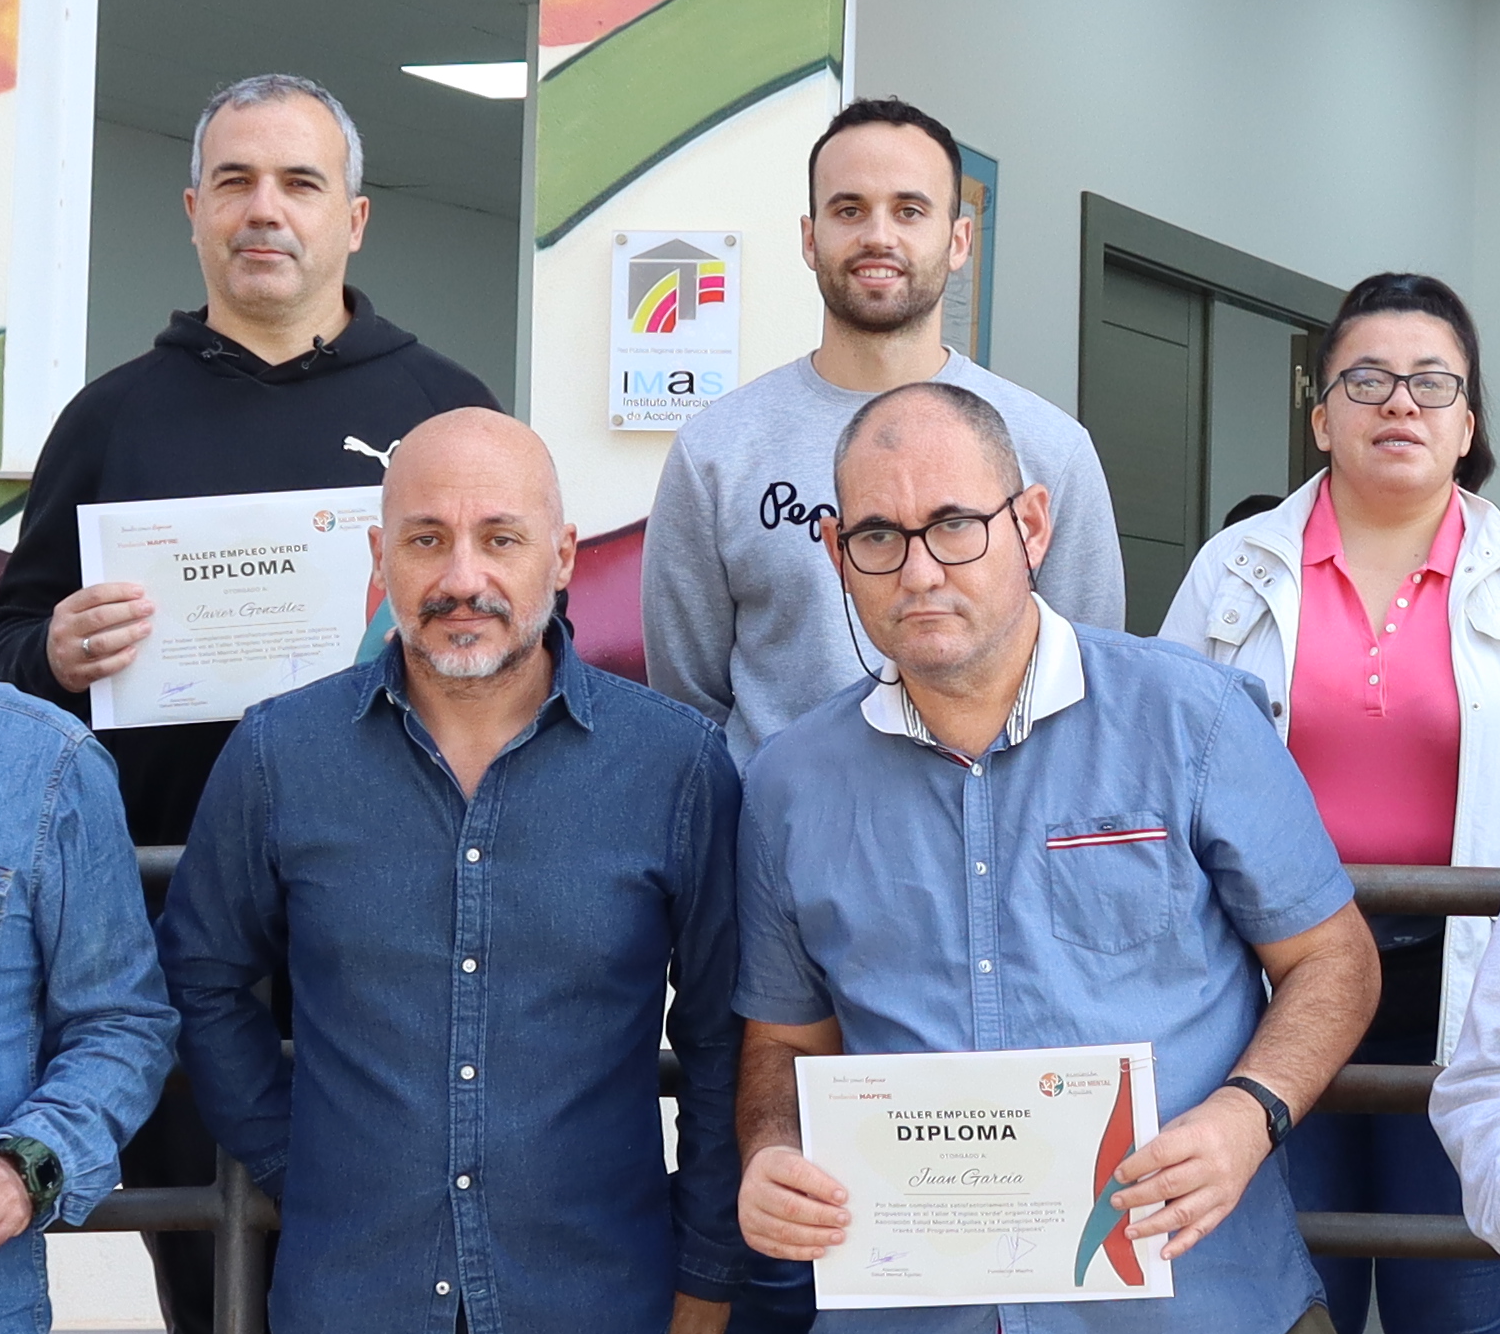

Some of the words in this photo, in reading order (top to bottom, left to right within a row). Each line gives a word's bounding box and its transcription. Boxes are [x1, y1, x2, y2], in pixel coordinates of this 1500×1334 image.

[623, 397, 667, 407] Instituto
[671, 398, 715, 408] Murcia
[627, 411, 641, 420] de
[643, 411, 682, 420] Acción
[760, 481, 837, 542] Pep
[174, 549, 216, 562] TALLER
[220, 547, 266, 559] EMPLEO
[271, 544, 308, 555] VERDE
[183, 559, 296, 581] DIPLOMA
[887, 1110, 932, 1119] TALLER
[936, 1110, 986, 1119] EMPLEO
[990, 1109, 1031, 1118] VERDE
[896, 1124, 1017, 1141] DIPLOMA
